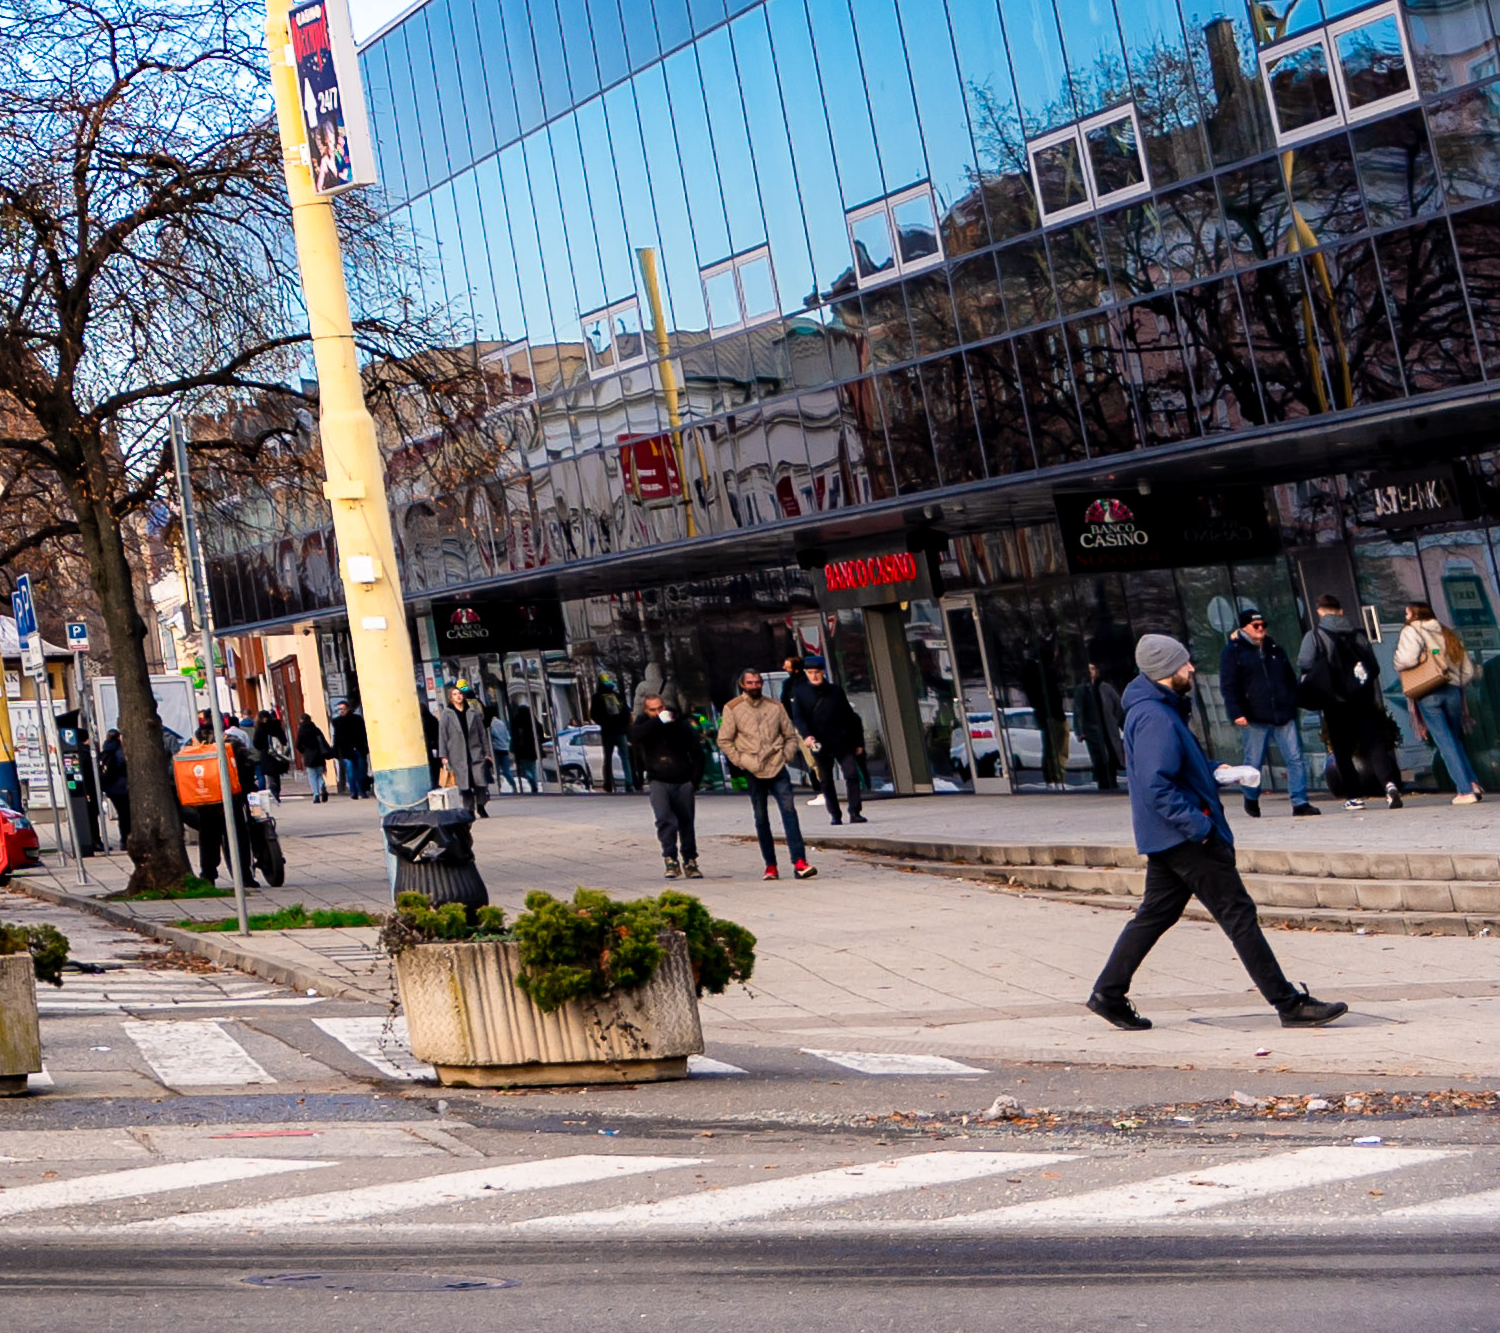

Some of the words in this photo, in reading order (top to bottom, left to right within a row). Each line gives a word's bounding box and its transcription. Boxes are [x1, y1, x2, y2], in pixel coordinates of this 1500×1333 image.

[1091, 522, 1135, 534] BANCO
[1079, 530, 1149, 548] CASINO
[824, 559, 869, 591] BANCO
[867, 552, 917, 586] CASINO
[72, 625, 81, 638] P
[446, 628, 489, 640] CASINO
[64, 729, 74, 743] P
